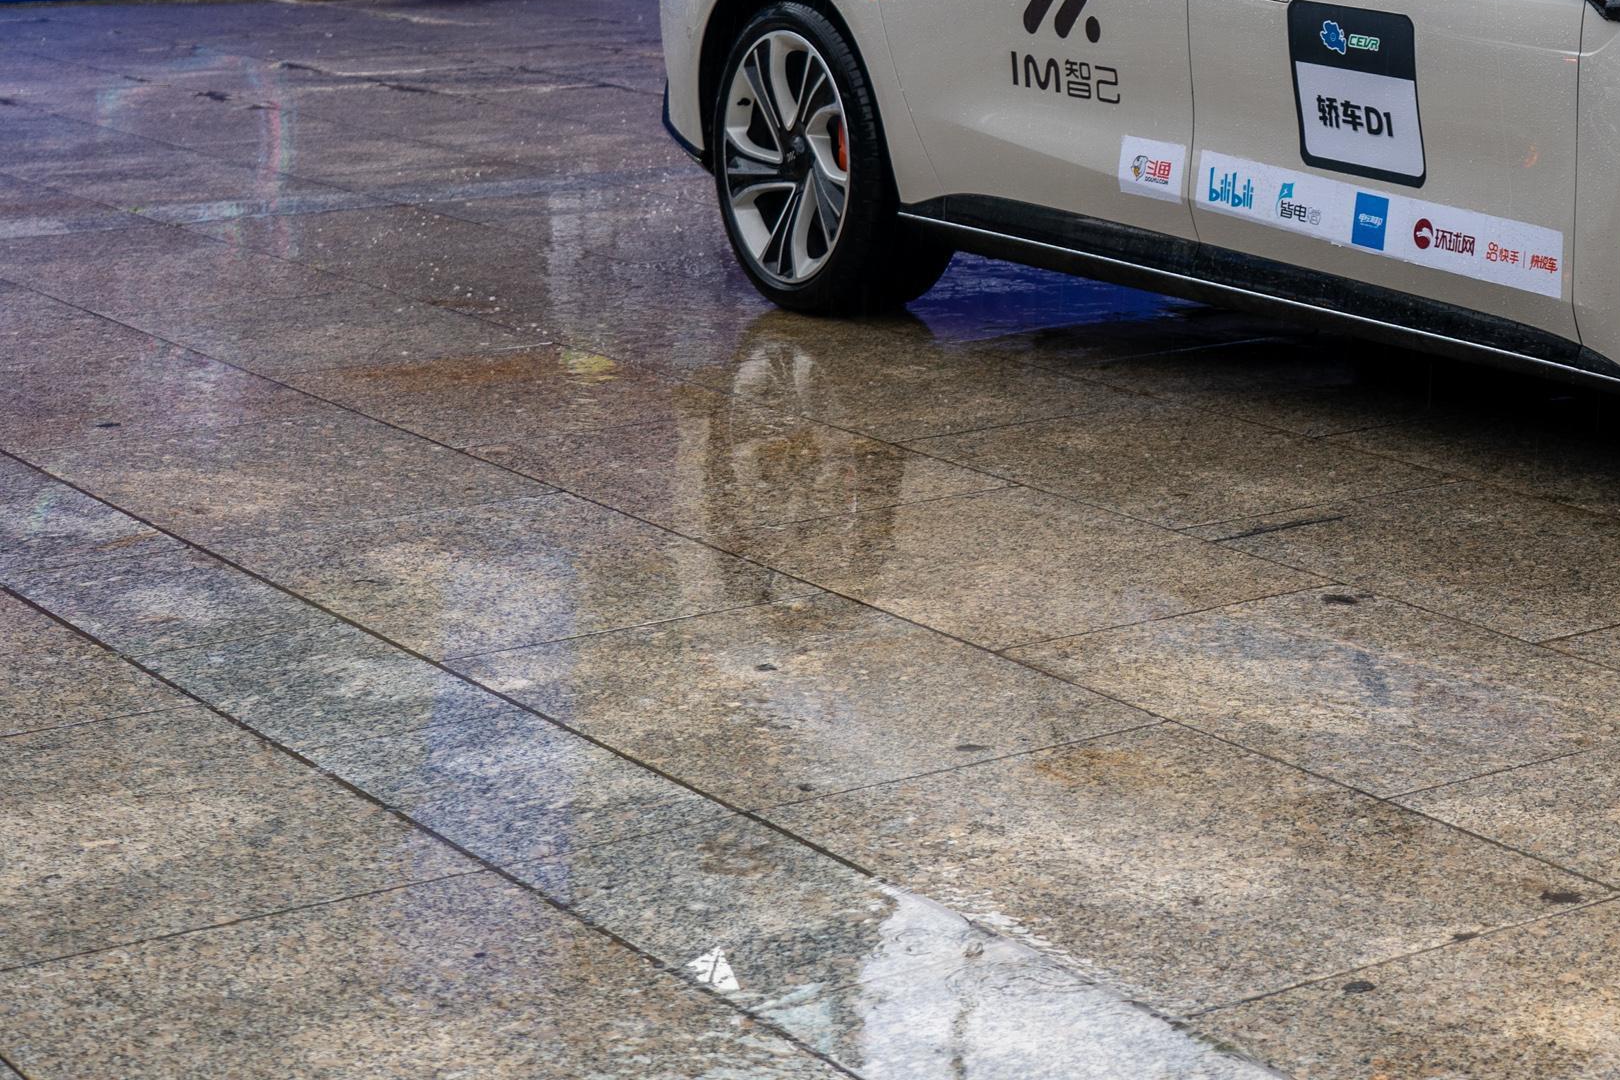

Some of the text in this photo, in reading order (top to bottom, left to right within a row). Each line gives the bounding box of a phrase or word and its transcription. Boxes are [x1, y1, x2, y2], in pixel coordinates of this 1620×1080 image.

[1348, 33, 1381, 51] CEVR
[1317, 94, 1394, 138] 轿车D1
[1145, 159, 1172, 180] 斗鱼
[1209, 167, 1254, 209] bilibili
[1434, 228, 1476, 257] 环球网
[1499, 247, 1520, 265] 快手
